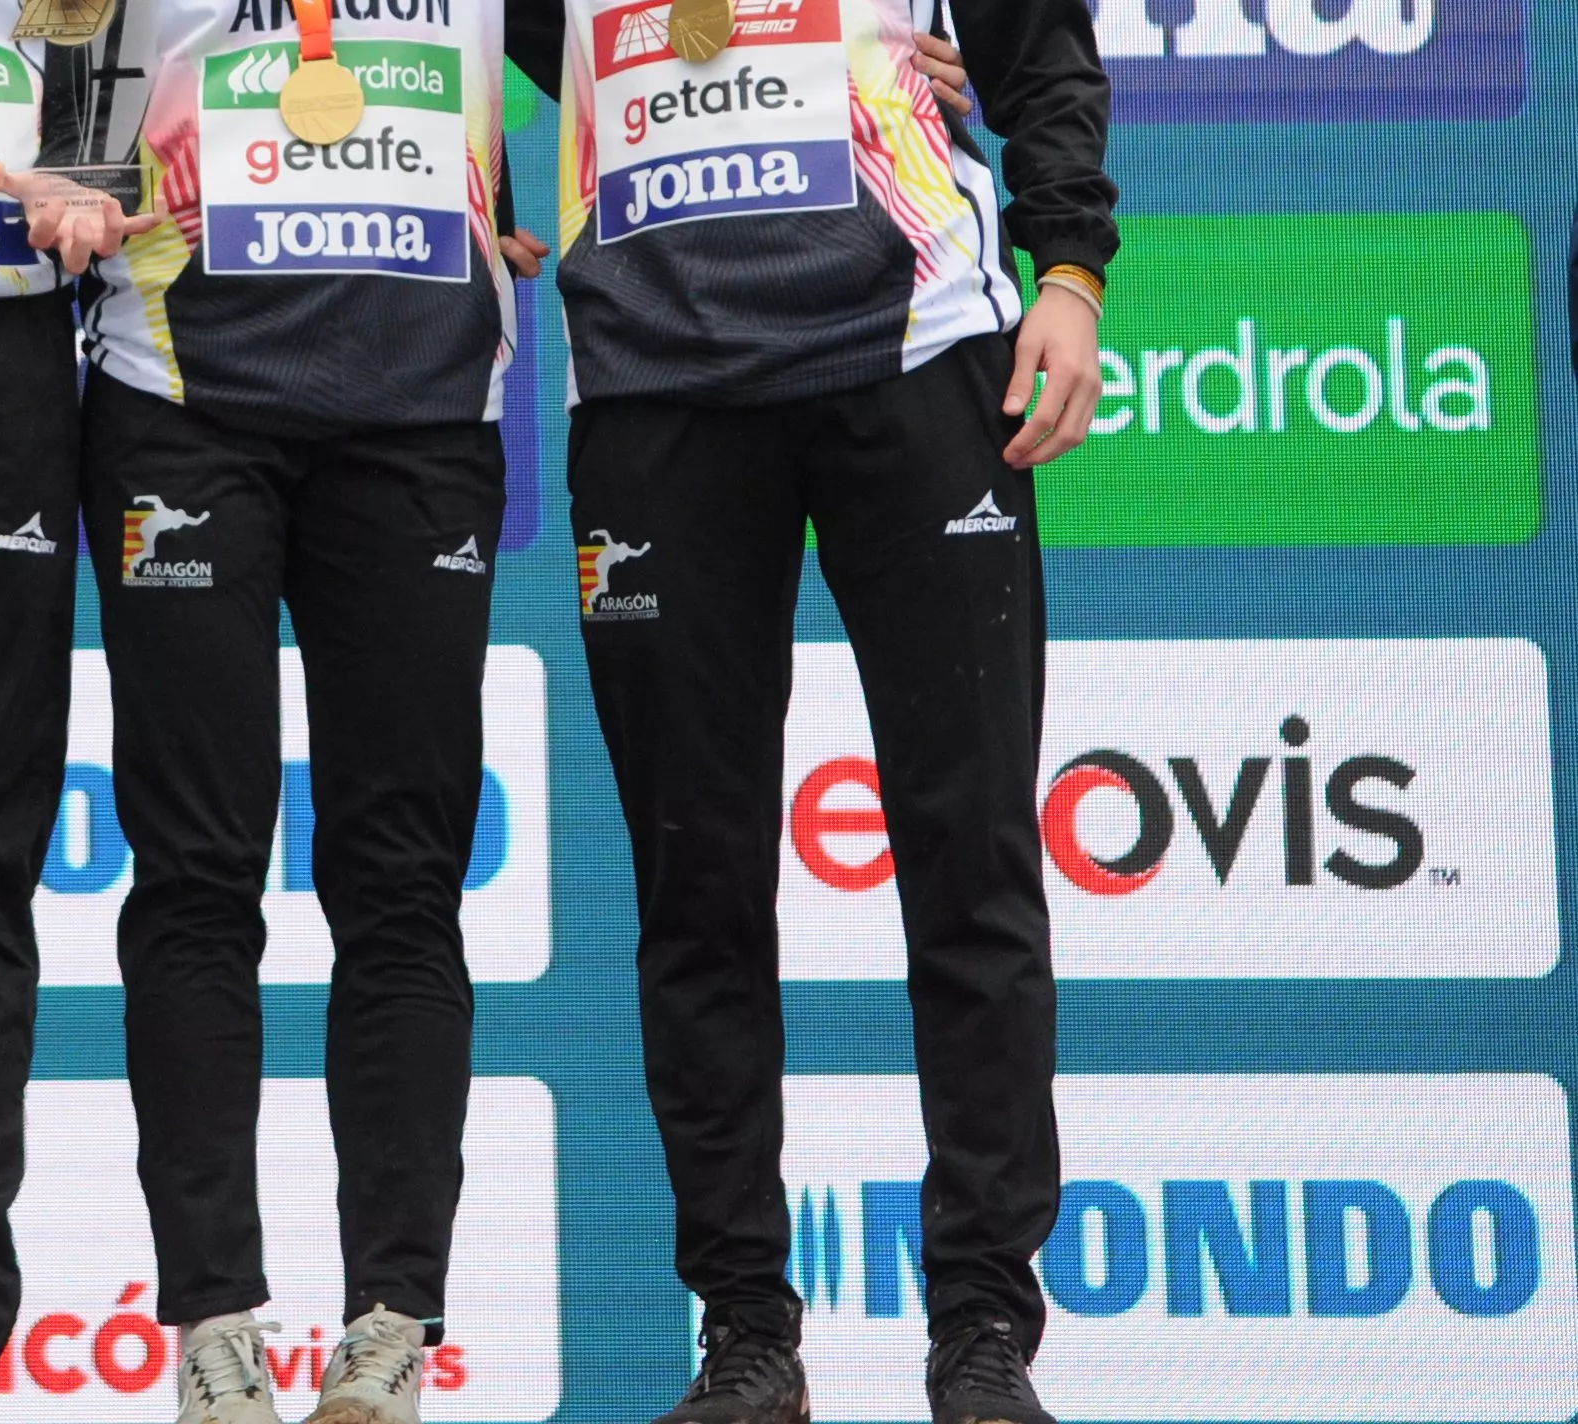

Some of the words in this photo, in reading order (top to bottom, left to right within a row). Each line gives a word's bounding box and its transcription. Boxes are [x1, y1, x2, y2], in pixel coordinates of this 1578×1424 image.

[623, 65, 805, 145] getafe.
[945, 516, 1017, 534] MERCURY
[143, 559, 212, 577] ARAGÓN
[600, 592, 658, 611] ARAGÓN
[791, 714, 1425, 895] eovis
